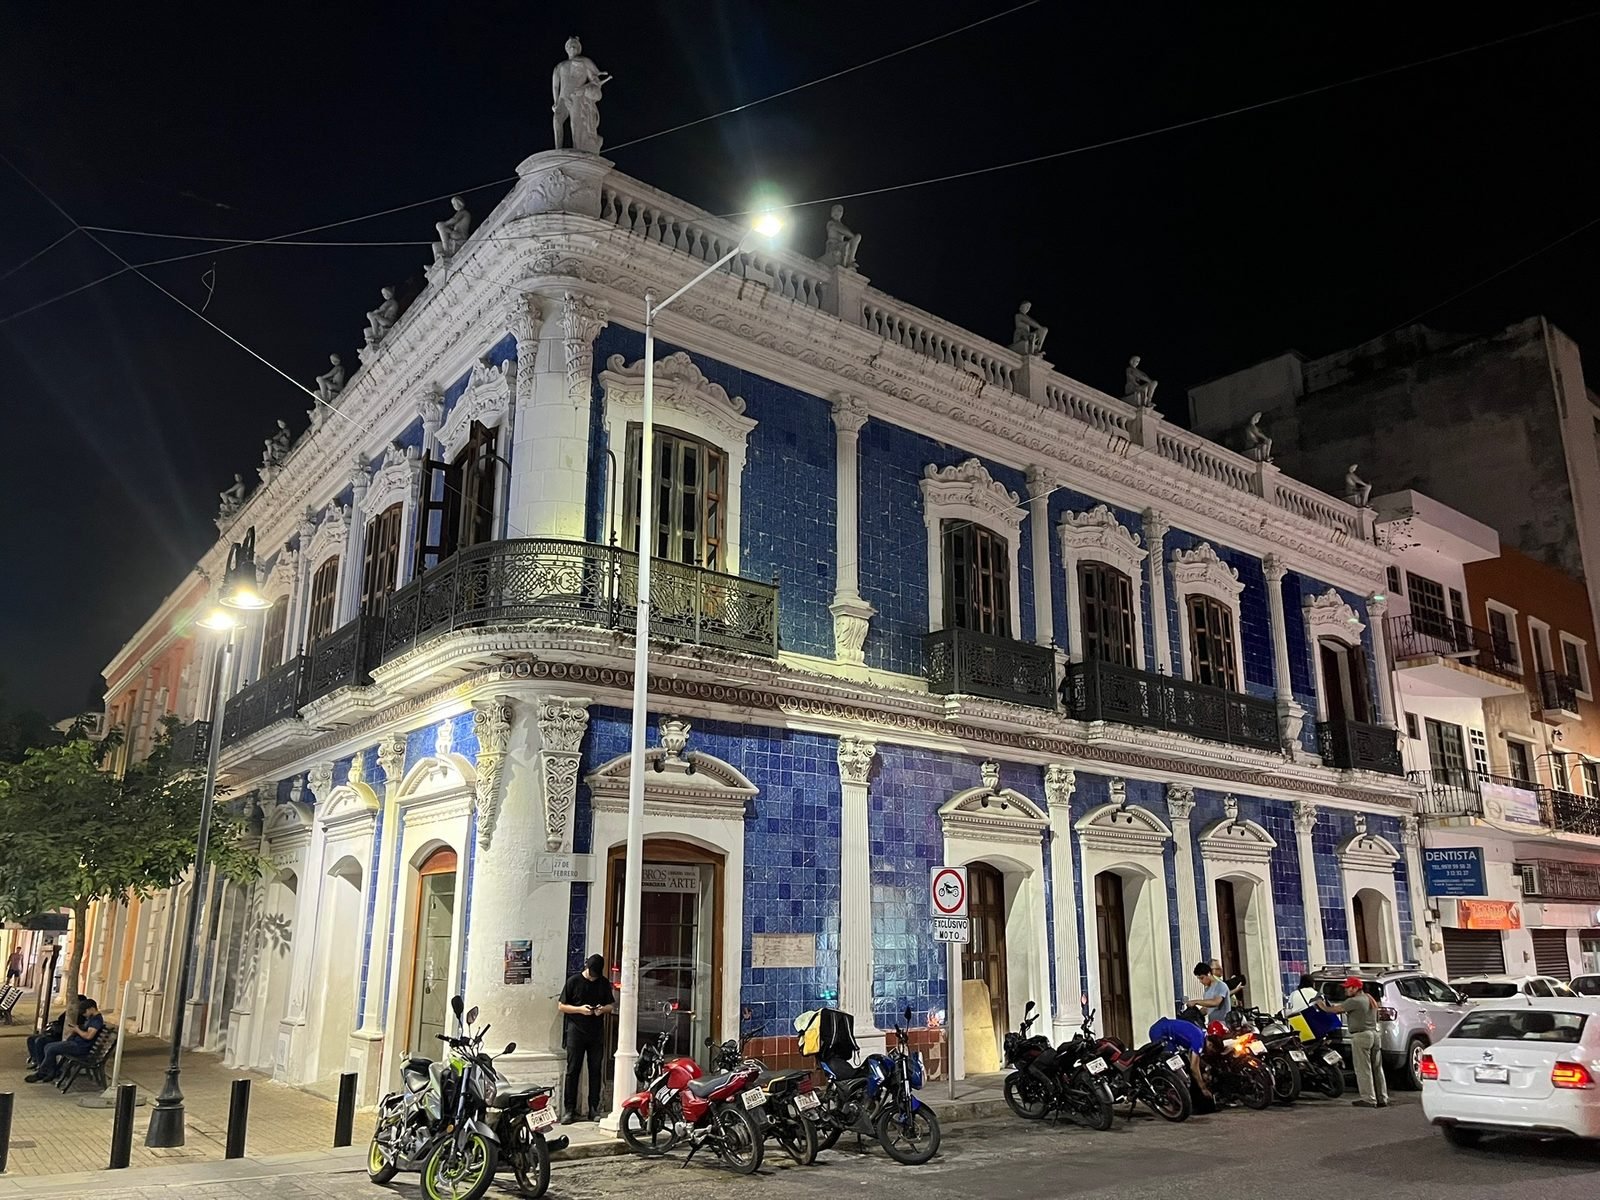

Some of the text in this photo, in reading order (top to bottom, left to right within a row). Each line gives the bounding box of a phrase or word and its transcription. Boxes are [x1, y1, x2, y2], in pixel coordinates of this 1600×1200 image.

[1425, 851, 1477, 861] DENTISTA
[553, 870, 579, 878] FEBRERO
[670, 878, 696, 889] ARTE
[934, 919, 967, 929] EXCLUSIVO
[939, 931, 960, 940] MOTO
